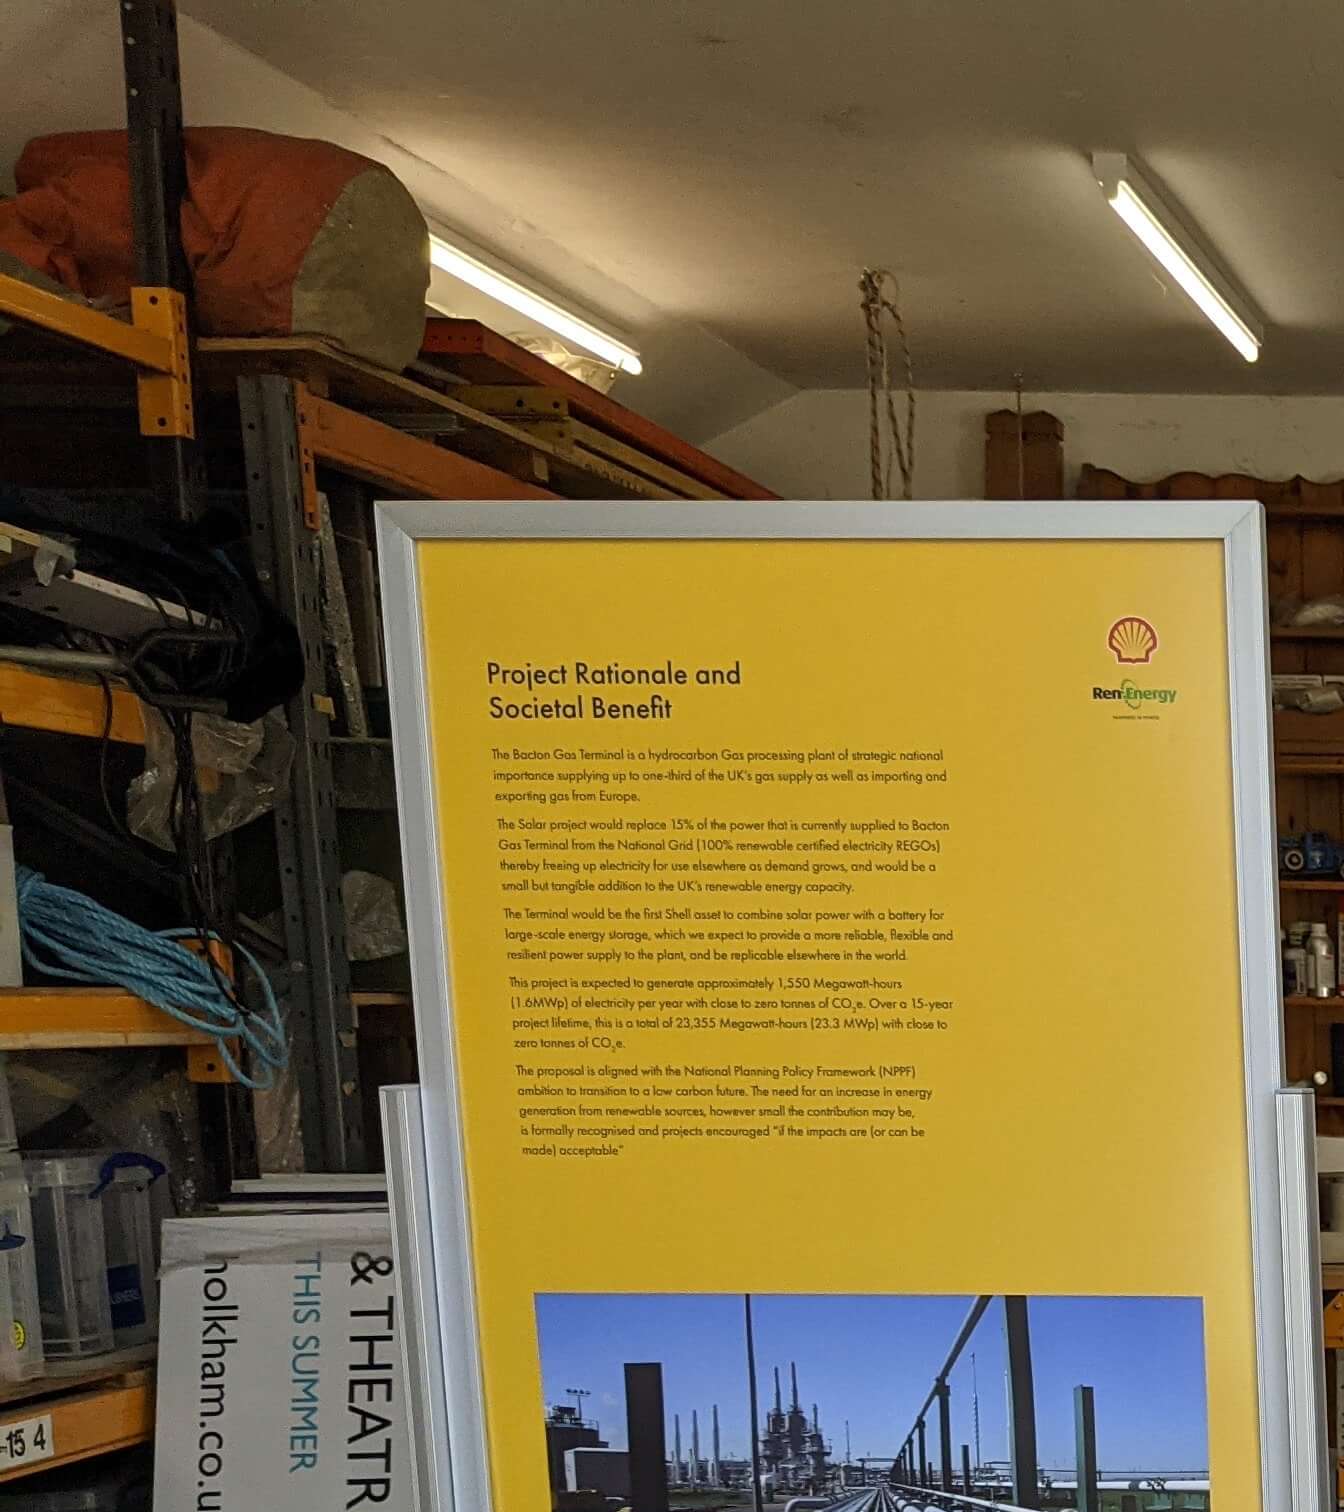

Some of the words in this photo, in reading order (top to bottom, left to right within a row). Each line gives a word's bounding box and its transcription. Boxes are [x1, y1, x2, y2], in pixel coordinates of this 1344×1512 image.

[487, 662, 568, 692] Project
[575, 660, 688, 686] Rationale
[695, 660, 741, 686] and
[489, 694, 584, 720] Societal
[591, 694, 673, 720] Benefit
[491, 747, 511, 761] The
[512, 747, 551, 760] Bacton
[552, 747, 577, 760] Gas
[578, 746, 625, 760] Terminal
[626, 748, 636, 760] is
[637, 751, 647, 760] a
[647, 747, 719, 765] hydrocarbon
[720, 748, 745, 762] Gas
[746, 749, 806, 765] processing
[807, 748, 836, 765] plant
[837, 748, 849, 762] of
[851, 750, 897, 765] strategic
[899, 749, 944, 762] national
[493, 767, 555, 784] importance
[555, 768, 610, 785] supplying
[611, 771, 627, 785] up
[628, 770, 640, 782] to
[642, 768, 693, 782] one-third
[694, 767, 707, 782] of
[707, 767, 725, 782] the
[726, 769, 753, 782] UK's
[754, 772, 776, 785] gas
[777, 768, 814, 785] supply
[815, 773, 829, 782] as
[830, 768, 854, 782] well
[855, 773, 870, 783] as
[871, 770, 923, 786] importing
[925, 769, 948, 783] and
[512, 1017, 550, 1032] project
[550, 1015, 593, 1031] lifetime,
[594, 1015, 613, 1030] this
[615, 1017, 624, 1029] is
[625, 1020, 634, 1029] a
[635, 1015, 660, 1029] total
[661, 1015, 674, 1029] of
[675, 1016, 717, 1030] 23,355
[719, 1016, 808, 1032] Megawatt-hours
[810, 1016, 841, 1031] (23.3
[843, 1016, 879, 1032] MWp)
[881, 1016, 904, 1030] with
[906, 1016, 935, 1030] close
[936, 1018, 948, 1030] to
[351, 1252, 393, 1286] &
[293, 1251, 321, 1324] THIS
[289, 1336, 320, 1474] SUMMER
[34, 1424, 46, 1451] 4
